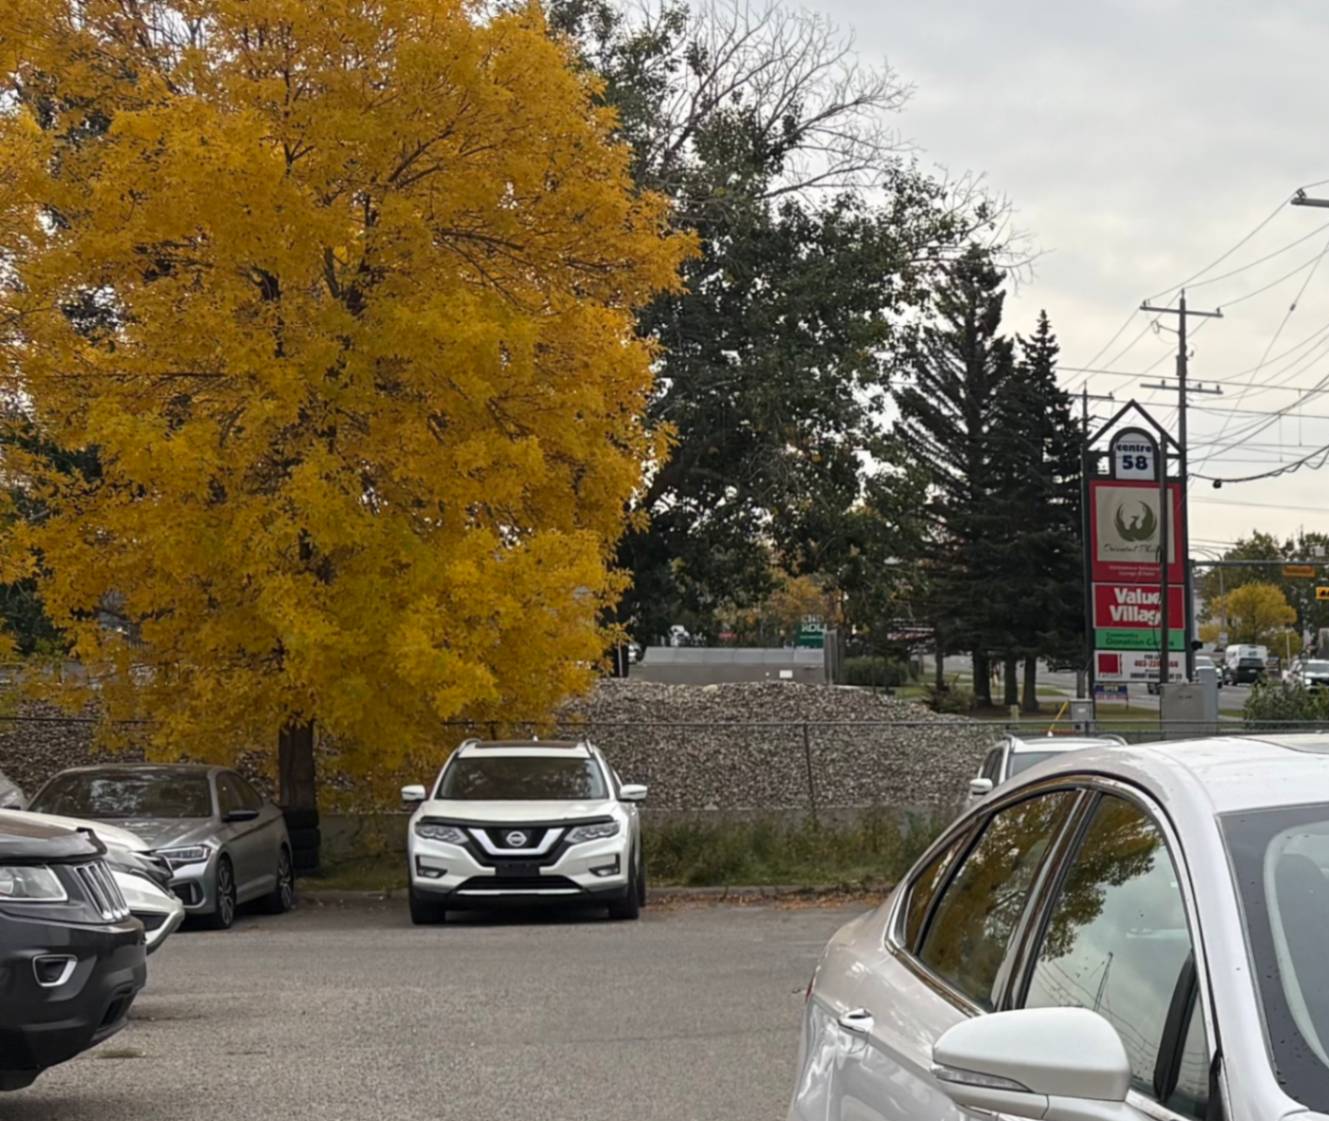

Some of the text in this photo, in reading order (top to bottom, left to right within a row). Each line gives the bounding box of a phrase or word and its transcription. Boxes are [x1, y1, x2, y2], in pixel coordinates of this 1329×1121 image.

[1117, 444, 1152, 452] centre
[1122, 455, 1148, 470] 58
[1109, 605, 1162, 626] Villag
